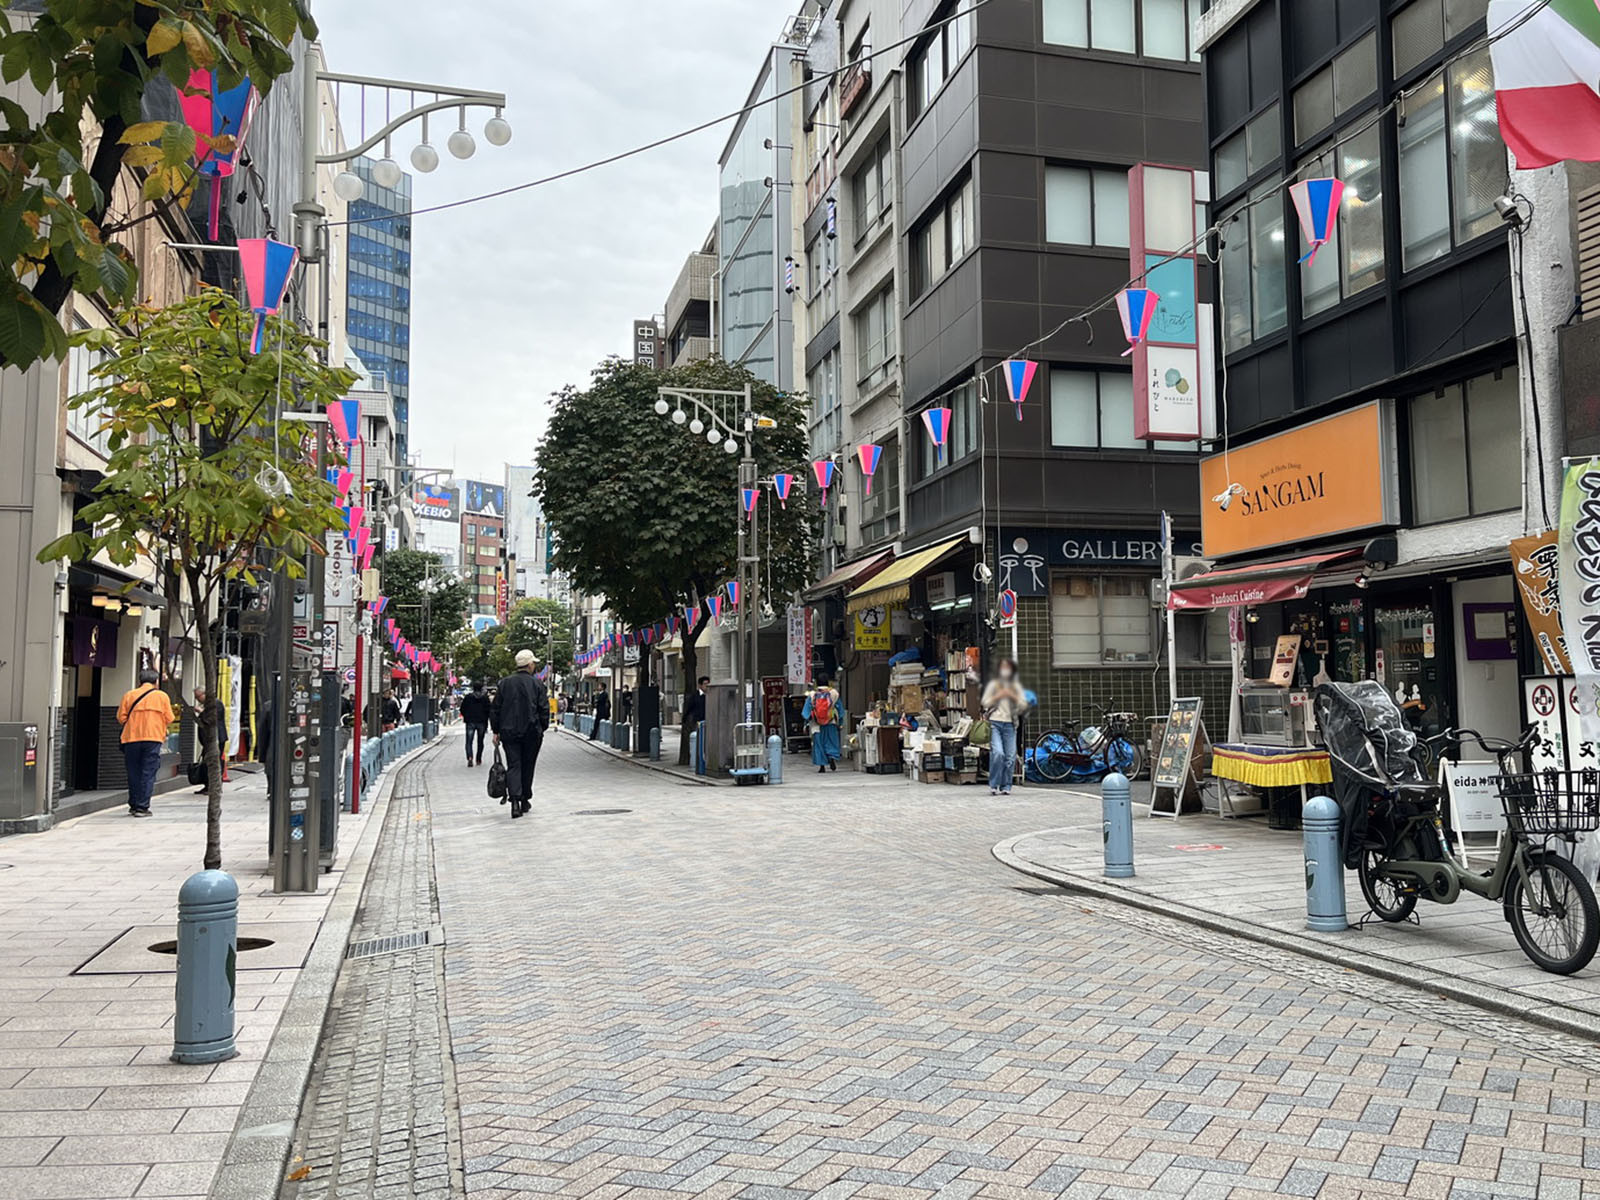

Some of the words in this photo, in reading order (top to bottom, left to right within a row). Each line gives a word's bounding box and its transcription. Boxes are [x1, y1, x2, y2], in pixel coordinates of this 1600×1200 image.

[1241, 472, 1325, 516] SANGAM
[1211, 592, 1239, 604] Tandoori
[1239, 589, 1264, 601] Cuisine
[1454, 776, 1477, 787] eida
